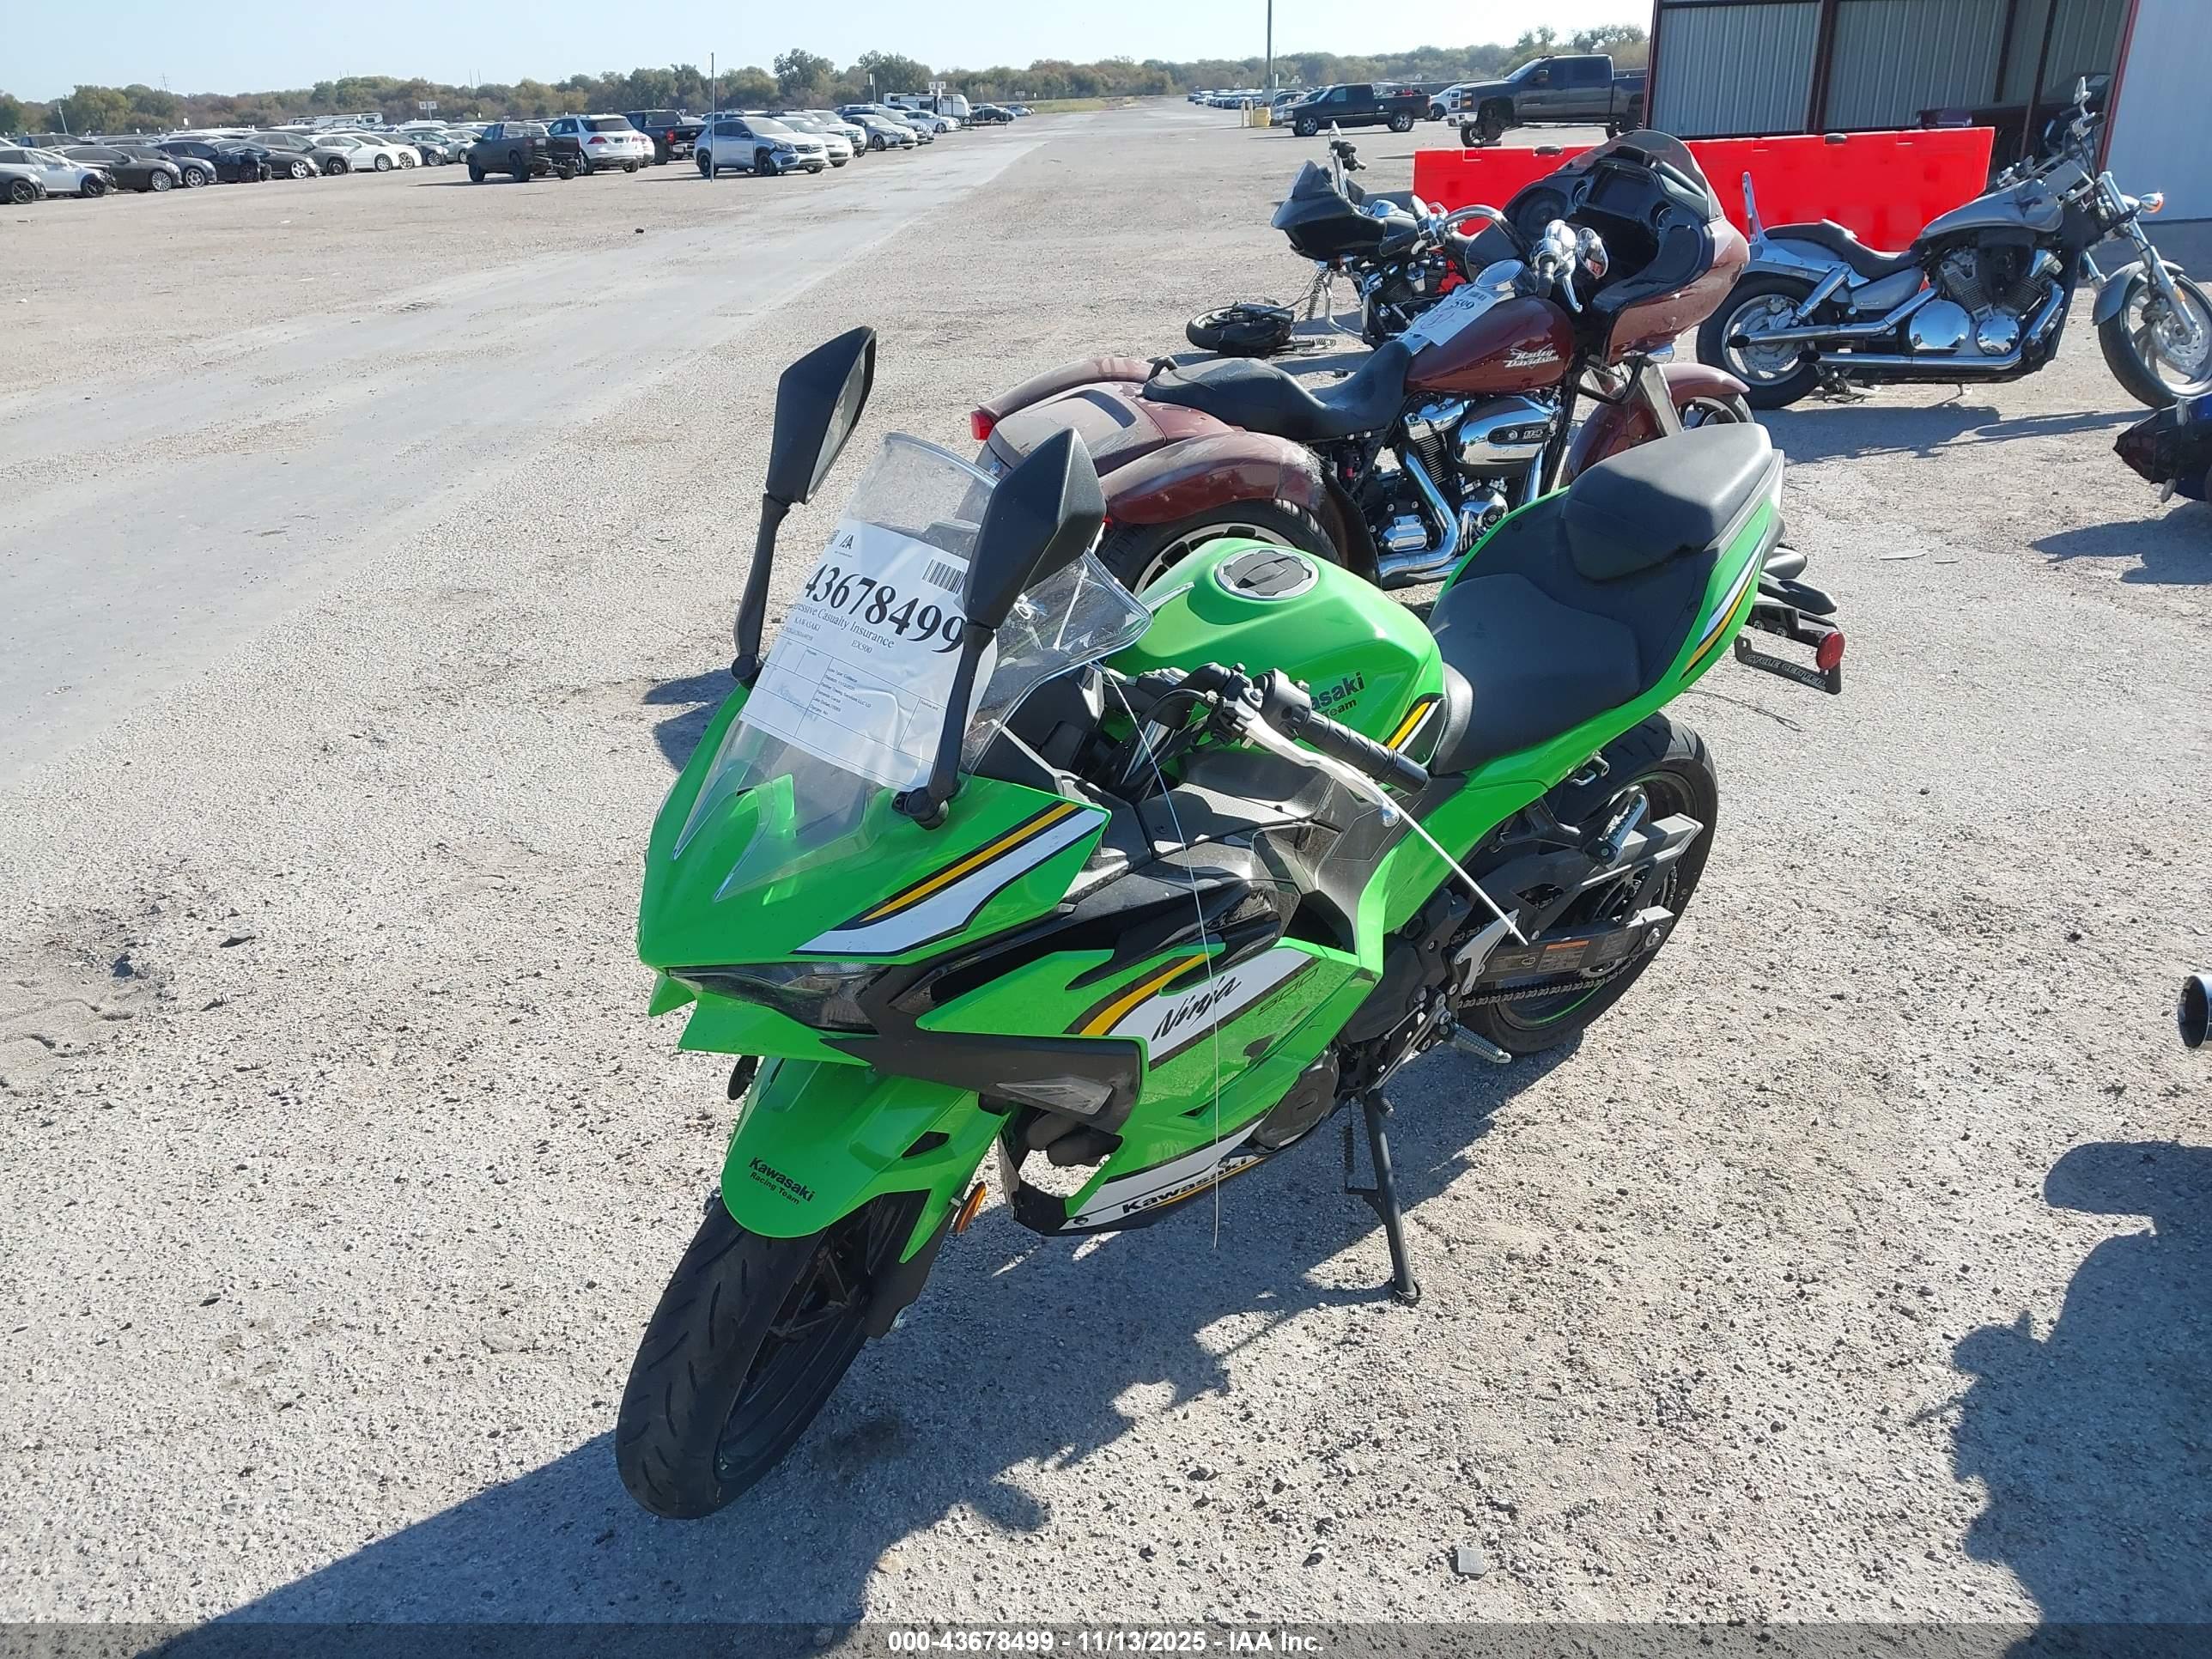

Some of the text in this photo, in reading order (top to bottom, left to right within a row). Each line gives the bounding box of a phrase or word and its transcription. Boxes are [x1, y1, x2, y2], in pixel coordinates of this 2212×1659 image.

[1504, 355, 1559, 368] Davidson
[1510, 343, 1556, 360] Harley
[805, 563, 963, 653] 43678499
[817, 608, 849, 630] Casualty
[850, 621, 895, 648] Insurance
[1311, 672, 1365, 710] asaki
[1745, 654, 1826, 689] CYCLE CENTER
[1151, 975, 1243, 1042] Ninja
[749, 1157, 816, 1202] Kawasaki
[750, 1171, 799, 1205] Racing Team
[1122, 1157, 1247, 1214] Kawasaki
